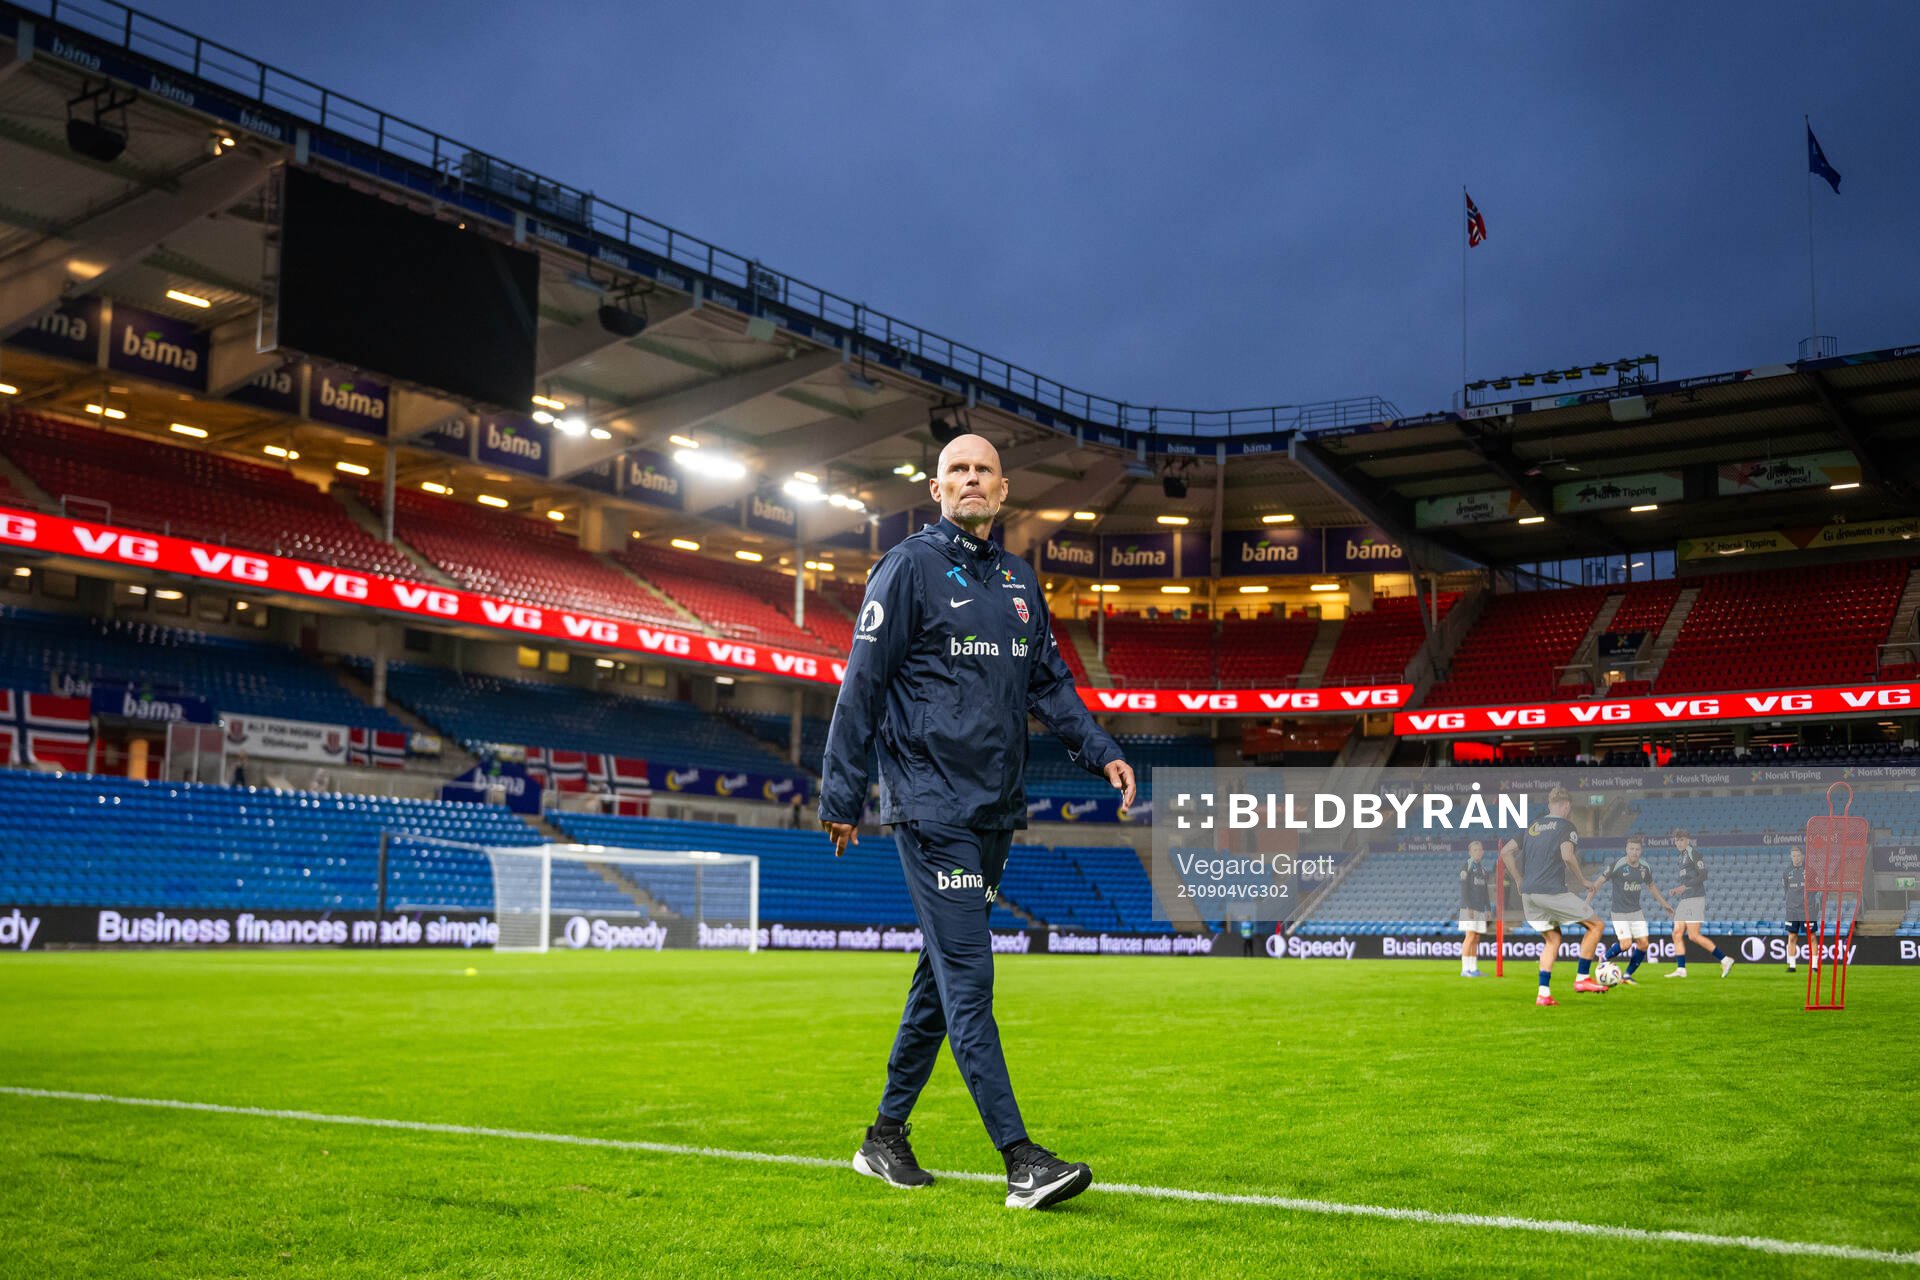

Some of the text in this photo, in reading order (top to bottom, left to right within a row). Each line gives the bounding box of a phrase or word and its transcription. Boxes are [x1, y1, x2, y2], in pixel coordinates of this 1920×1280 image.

[38, 312, 88, 342] ma
[123, 326, 198, 373] bama
[321, 378, 384, 420] bama
[487, 424, 542, 460] bama
[1243, 441, 1272, 455] bama
[630, 462, 678, 495] bama
[754, 496, 794, 526] bama
[1047, 540, 1094, 565] bama
[1112, 546, 1166, 567] bama
[1241, 542, 1298, 562] bama
[1346, 540, 1402, 560] bama
[0, 514, 36, 542] G
[73, 526, 159, 563] VG
[191, 547, 269, 582] VG
[297, 566, 368, 599] VG
[394, 584, 459, 616] VG
[480, 599, 543, 631] VG
[562, 614, 619, 644] VG
[637, 628, 690, 656] VG
[706, 641, 756, 667] VG
[771, 652, 818, 677] VG
[950, 636, 999, 656] bama
[123, 692, 183, 721] bama
[1098, 689, 1399, 710] VG VG VG VG
[1409, 689, 1911, 731] VG VG VG VG VG VG
[1592, 776, 1642, 788] Norsk Tipping
[1676, 773, 1730, 785] Norsk Tipping
[1765, 770, 1821, 782] Norsk Tipping
[1857, 766, 1917, 778] Norsk Tipping
[1511, 779, 1561, 790] Norsk Tipping
[937, 871, 983, 890] bama
[1623, 881, 1641, 892] bam
[98, 910, 498, 948] Business finances made simple
[590, 918, 668, 951] Speedy
[771, 923, 837, 948] finances
[838, 926, 881, 949] made
[881, 927, 924, 952] simpl
[991, 930, 1031, 954] peedy
[1048, 932, 1212, 955] Business finances made simple
[1288, 936, 1356, 960] Speedy
[1382, 936, 1463, 957] Business
